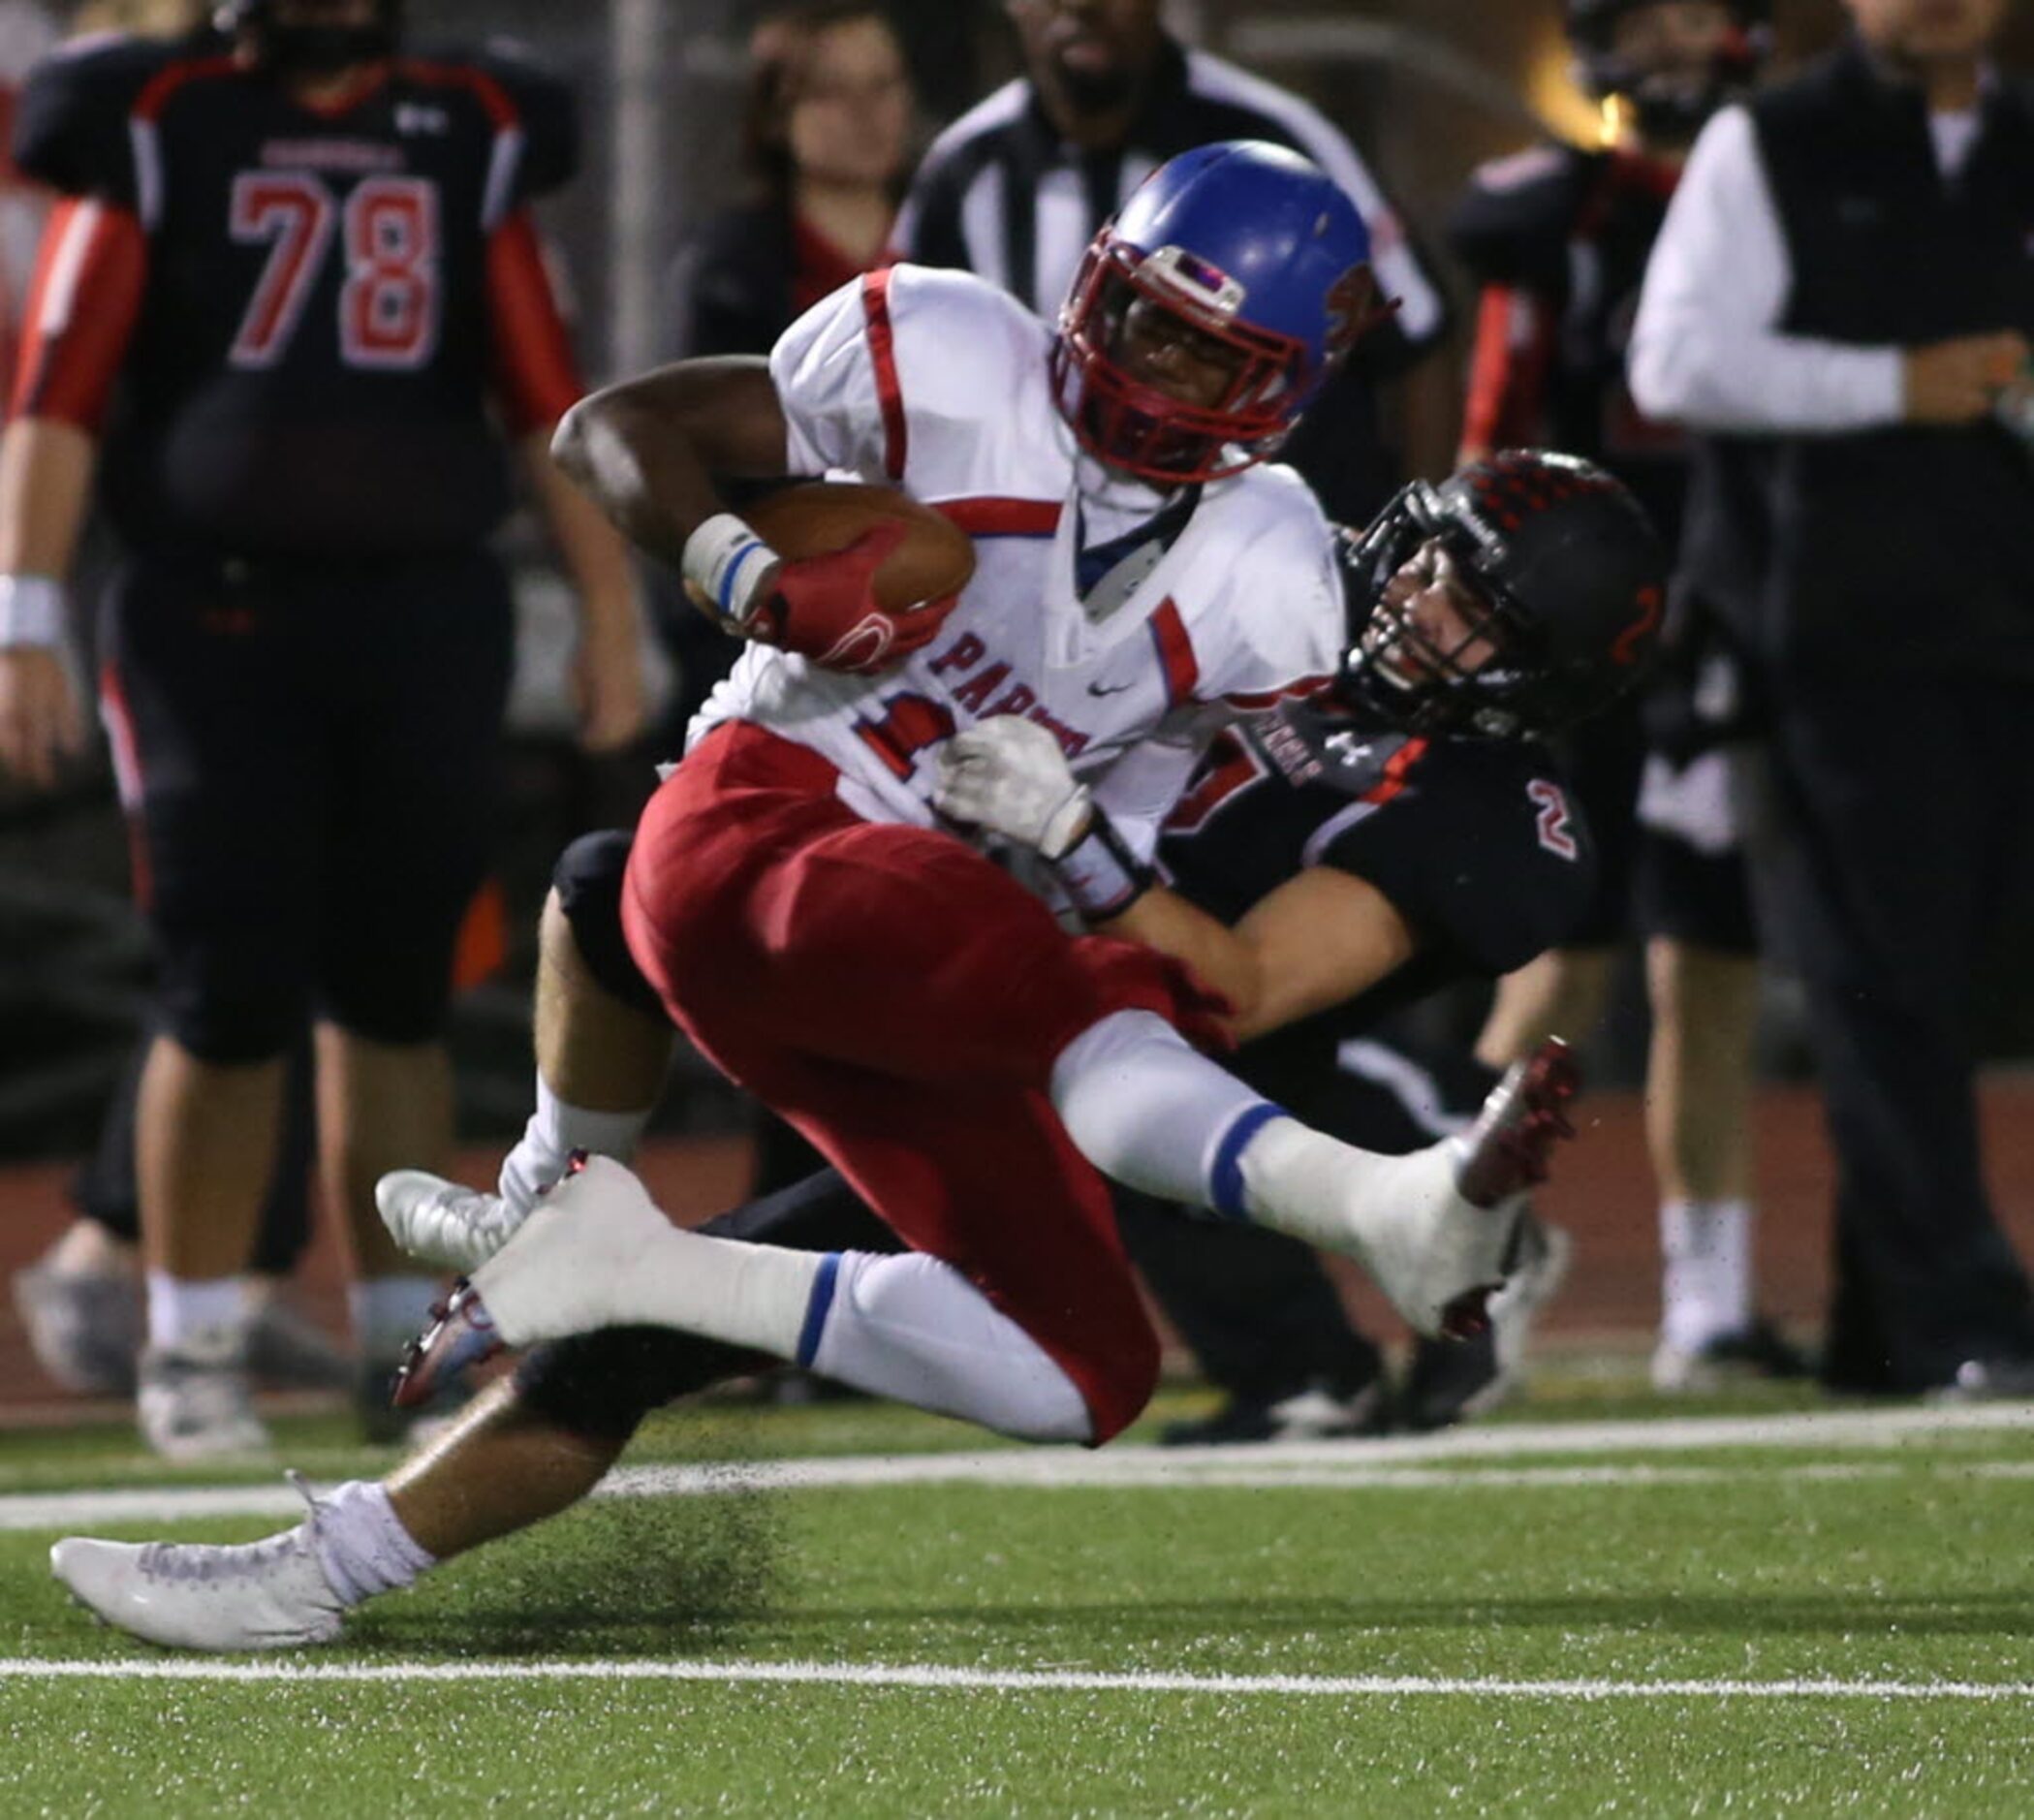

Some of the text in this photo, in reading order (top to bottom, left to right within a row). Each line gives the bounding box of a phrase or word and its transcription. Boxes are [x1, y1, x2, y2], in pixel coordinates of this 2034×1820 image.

[229, 172, 440, 367] 78
[1611, 585, 1664, 665] 2
[1526, 779, 1577, 860] 2
